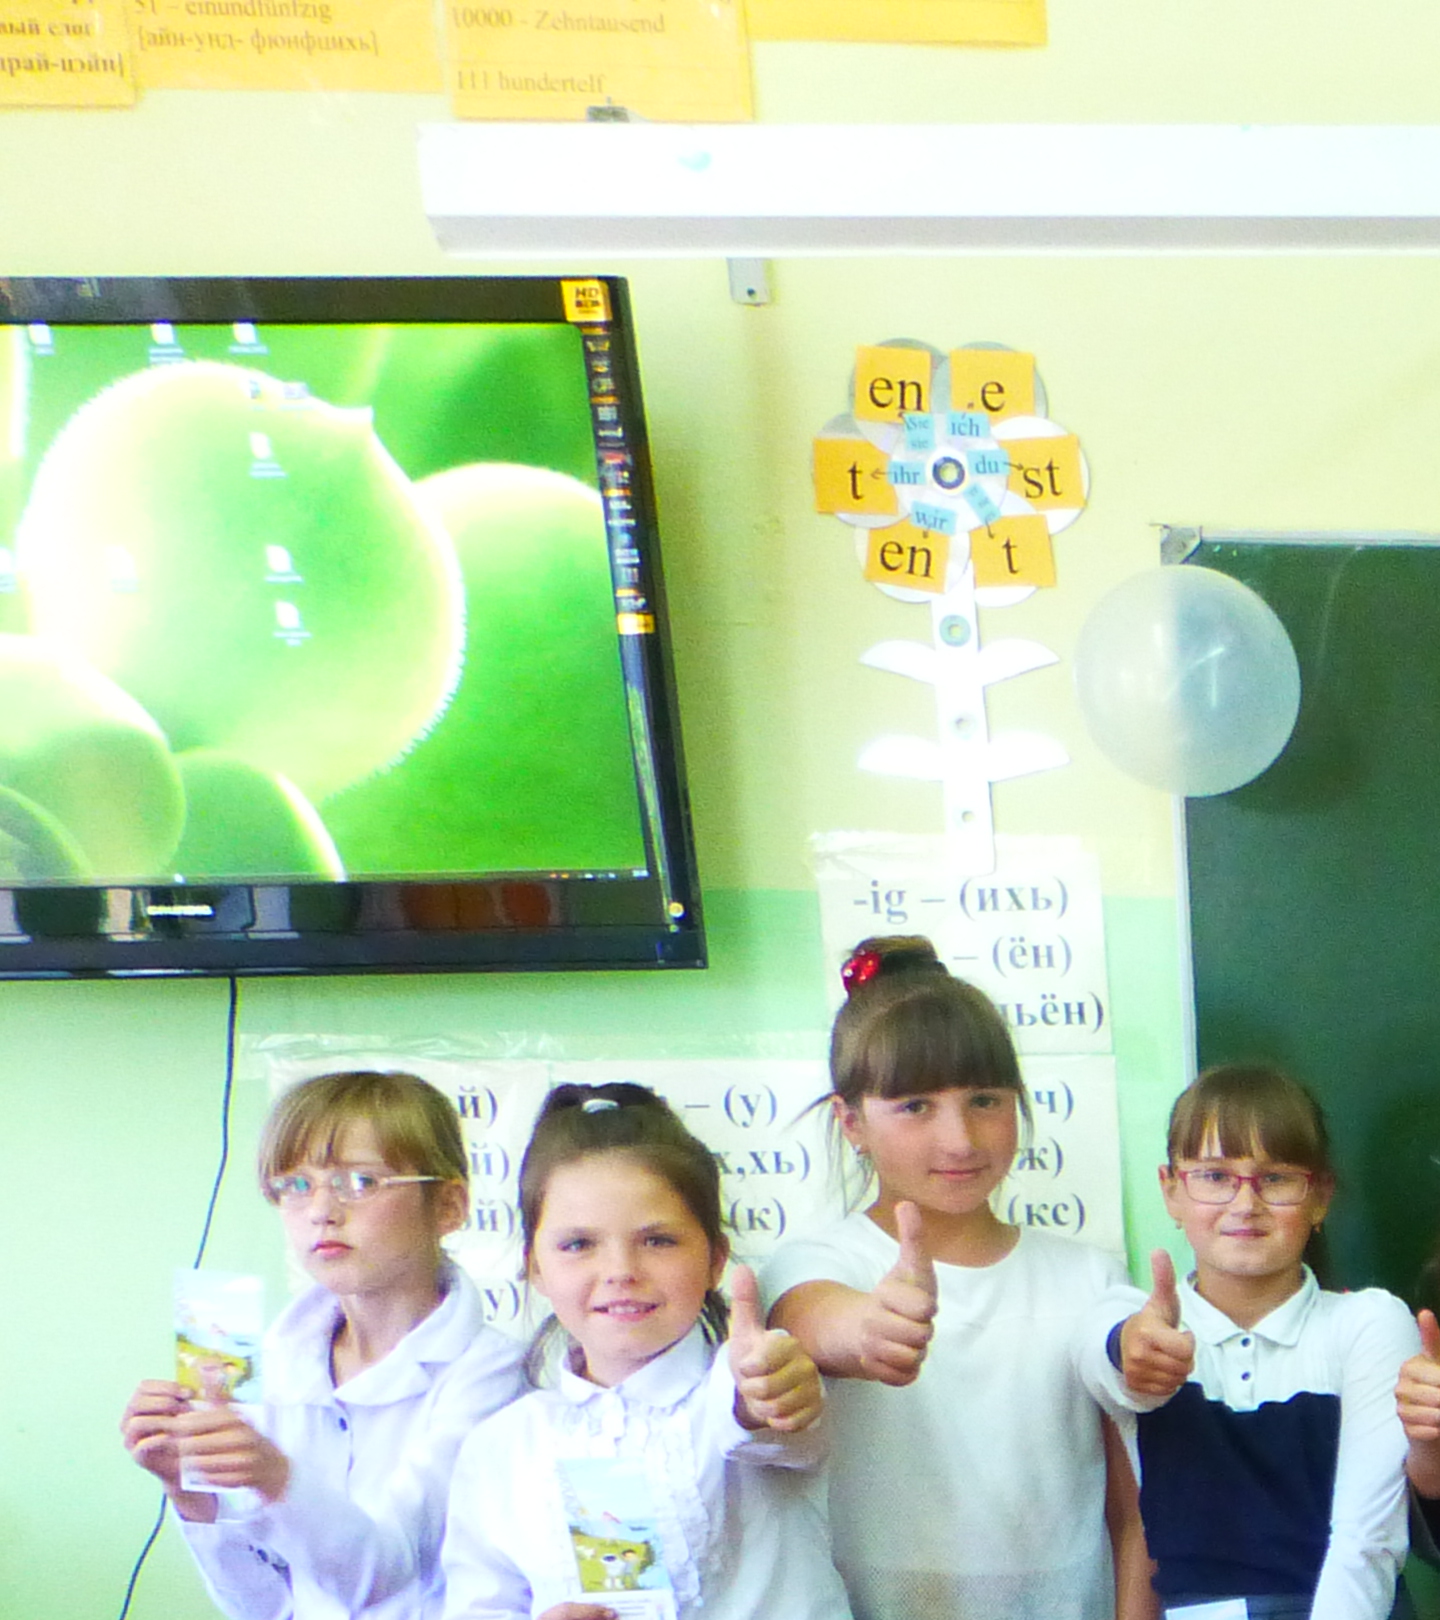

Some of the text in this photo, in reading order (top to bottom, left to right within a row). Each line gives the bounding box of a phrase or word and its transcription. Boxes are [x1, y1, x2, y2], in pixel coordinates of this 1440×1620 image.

[535, 9, 666, 34] Zehntausend
[499, 71, 606, 95] hundertelf
[868, 375, 923, 413] en
[980, 379, 1006, 413] e
[950, 418, 981, 438] ich
[847, 461, 863, 501] t
[893, 463, 920, 485] ihr
[975, 455, 999, 475] du
[1022, 457, 1063, 500] st
[915, 508, 948, 531] wir
[879, 539, 934, 579] en
[1001, 538, 1019, 575] t
[853, 879, 907, 923] -ig
[959, 876, 1069, 922] (ихь)
[992, 934, 1072, 978] (ён)
[723, 1084, 778, 1128] (у)
[728, 1197, 786, 1240] (к)
[1008, 1193, 1086, 1235] (кс)
